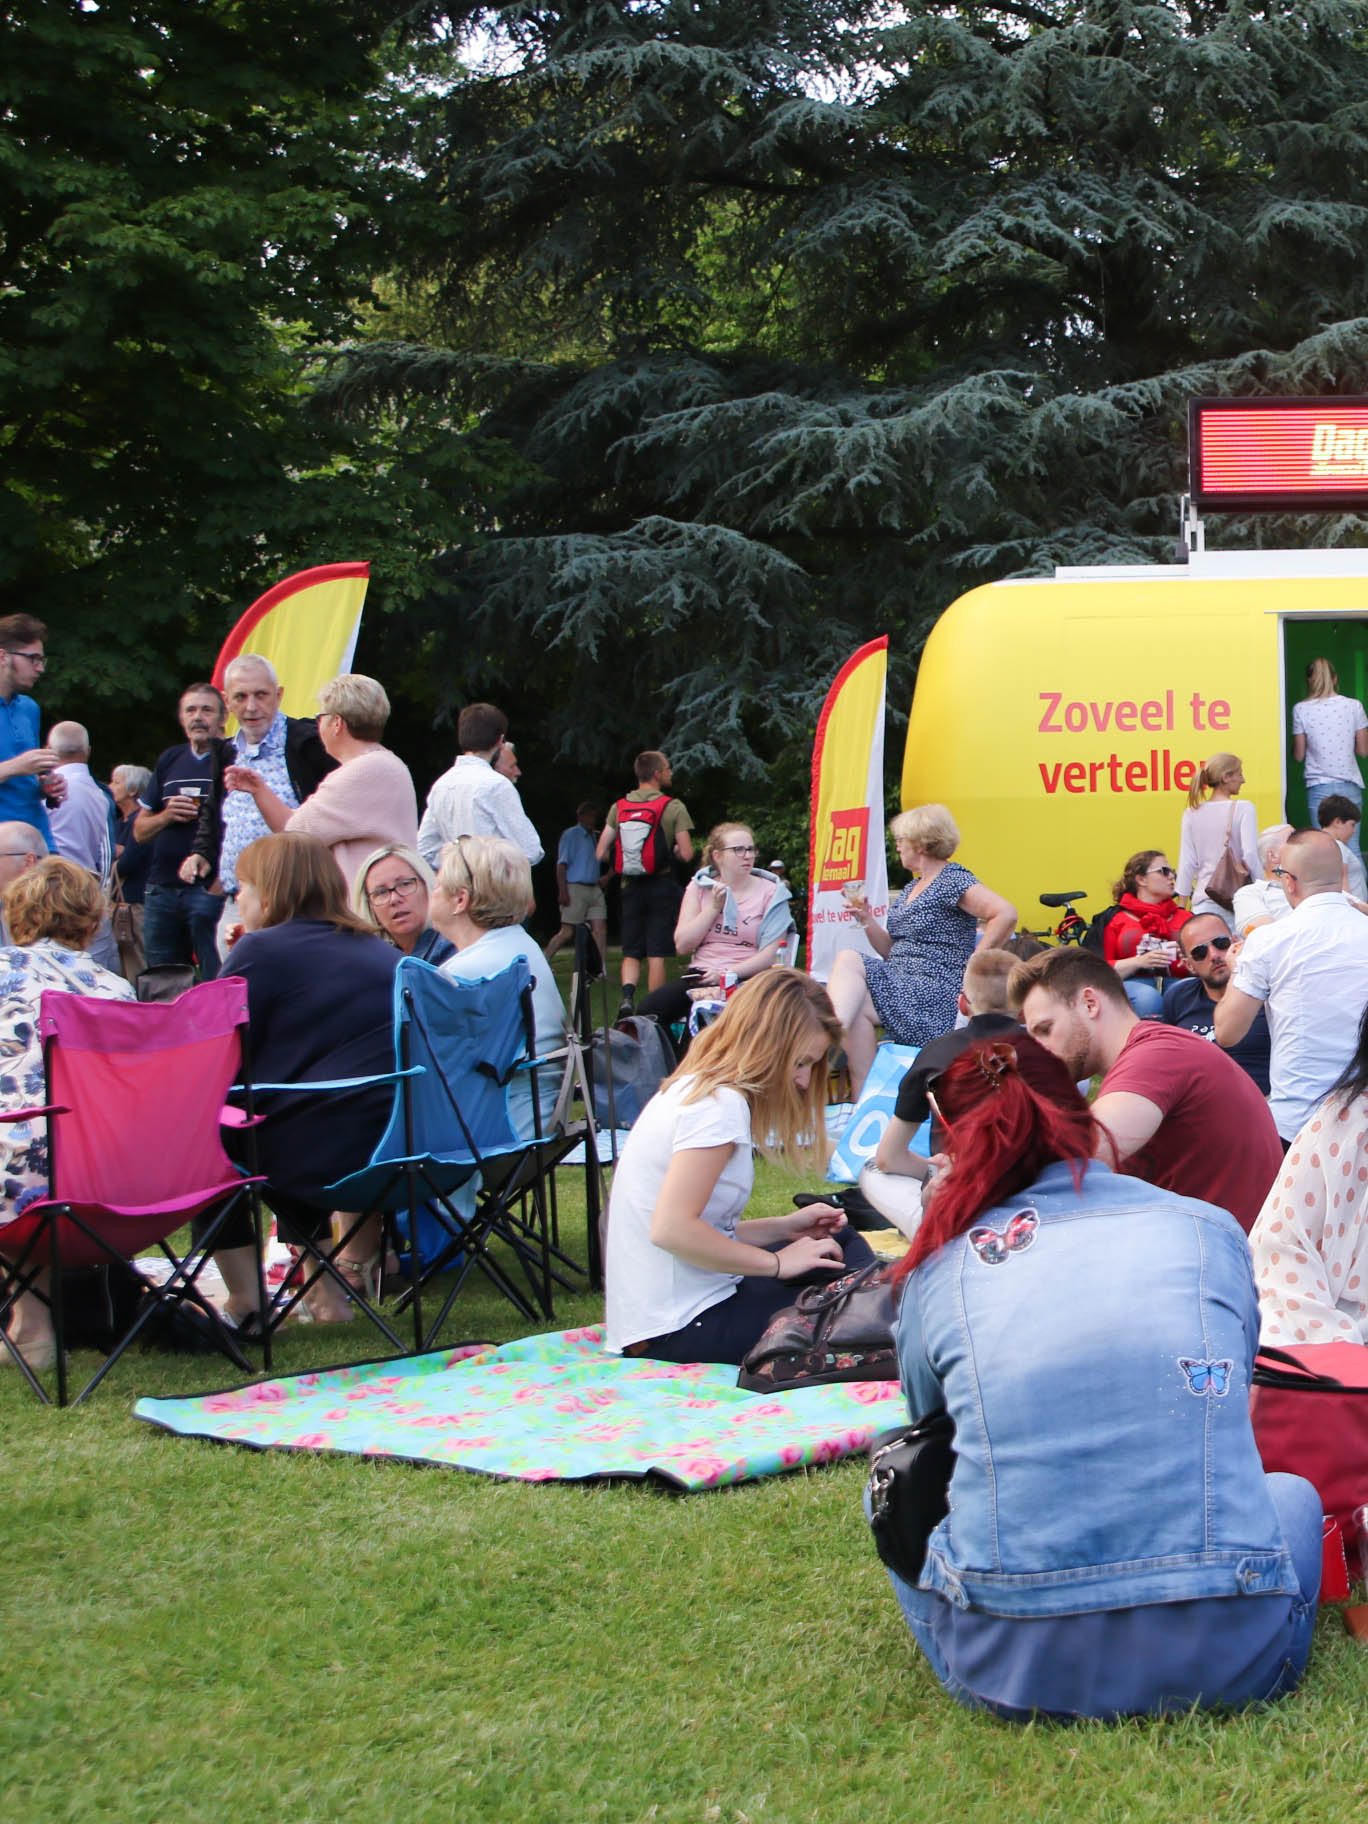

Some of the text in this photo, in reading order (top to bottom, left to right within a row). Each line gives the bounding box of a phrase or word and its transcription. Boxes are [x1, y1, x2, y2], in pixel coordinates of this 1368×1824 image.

[1038, 690, 1231, 733] Zoveel te
[1038, 749, 1208, 794] vertelle
